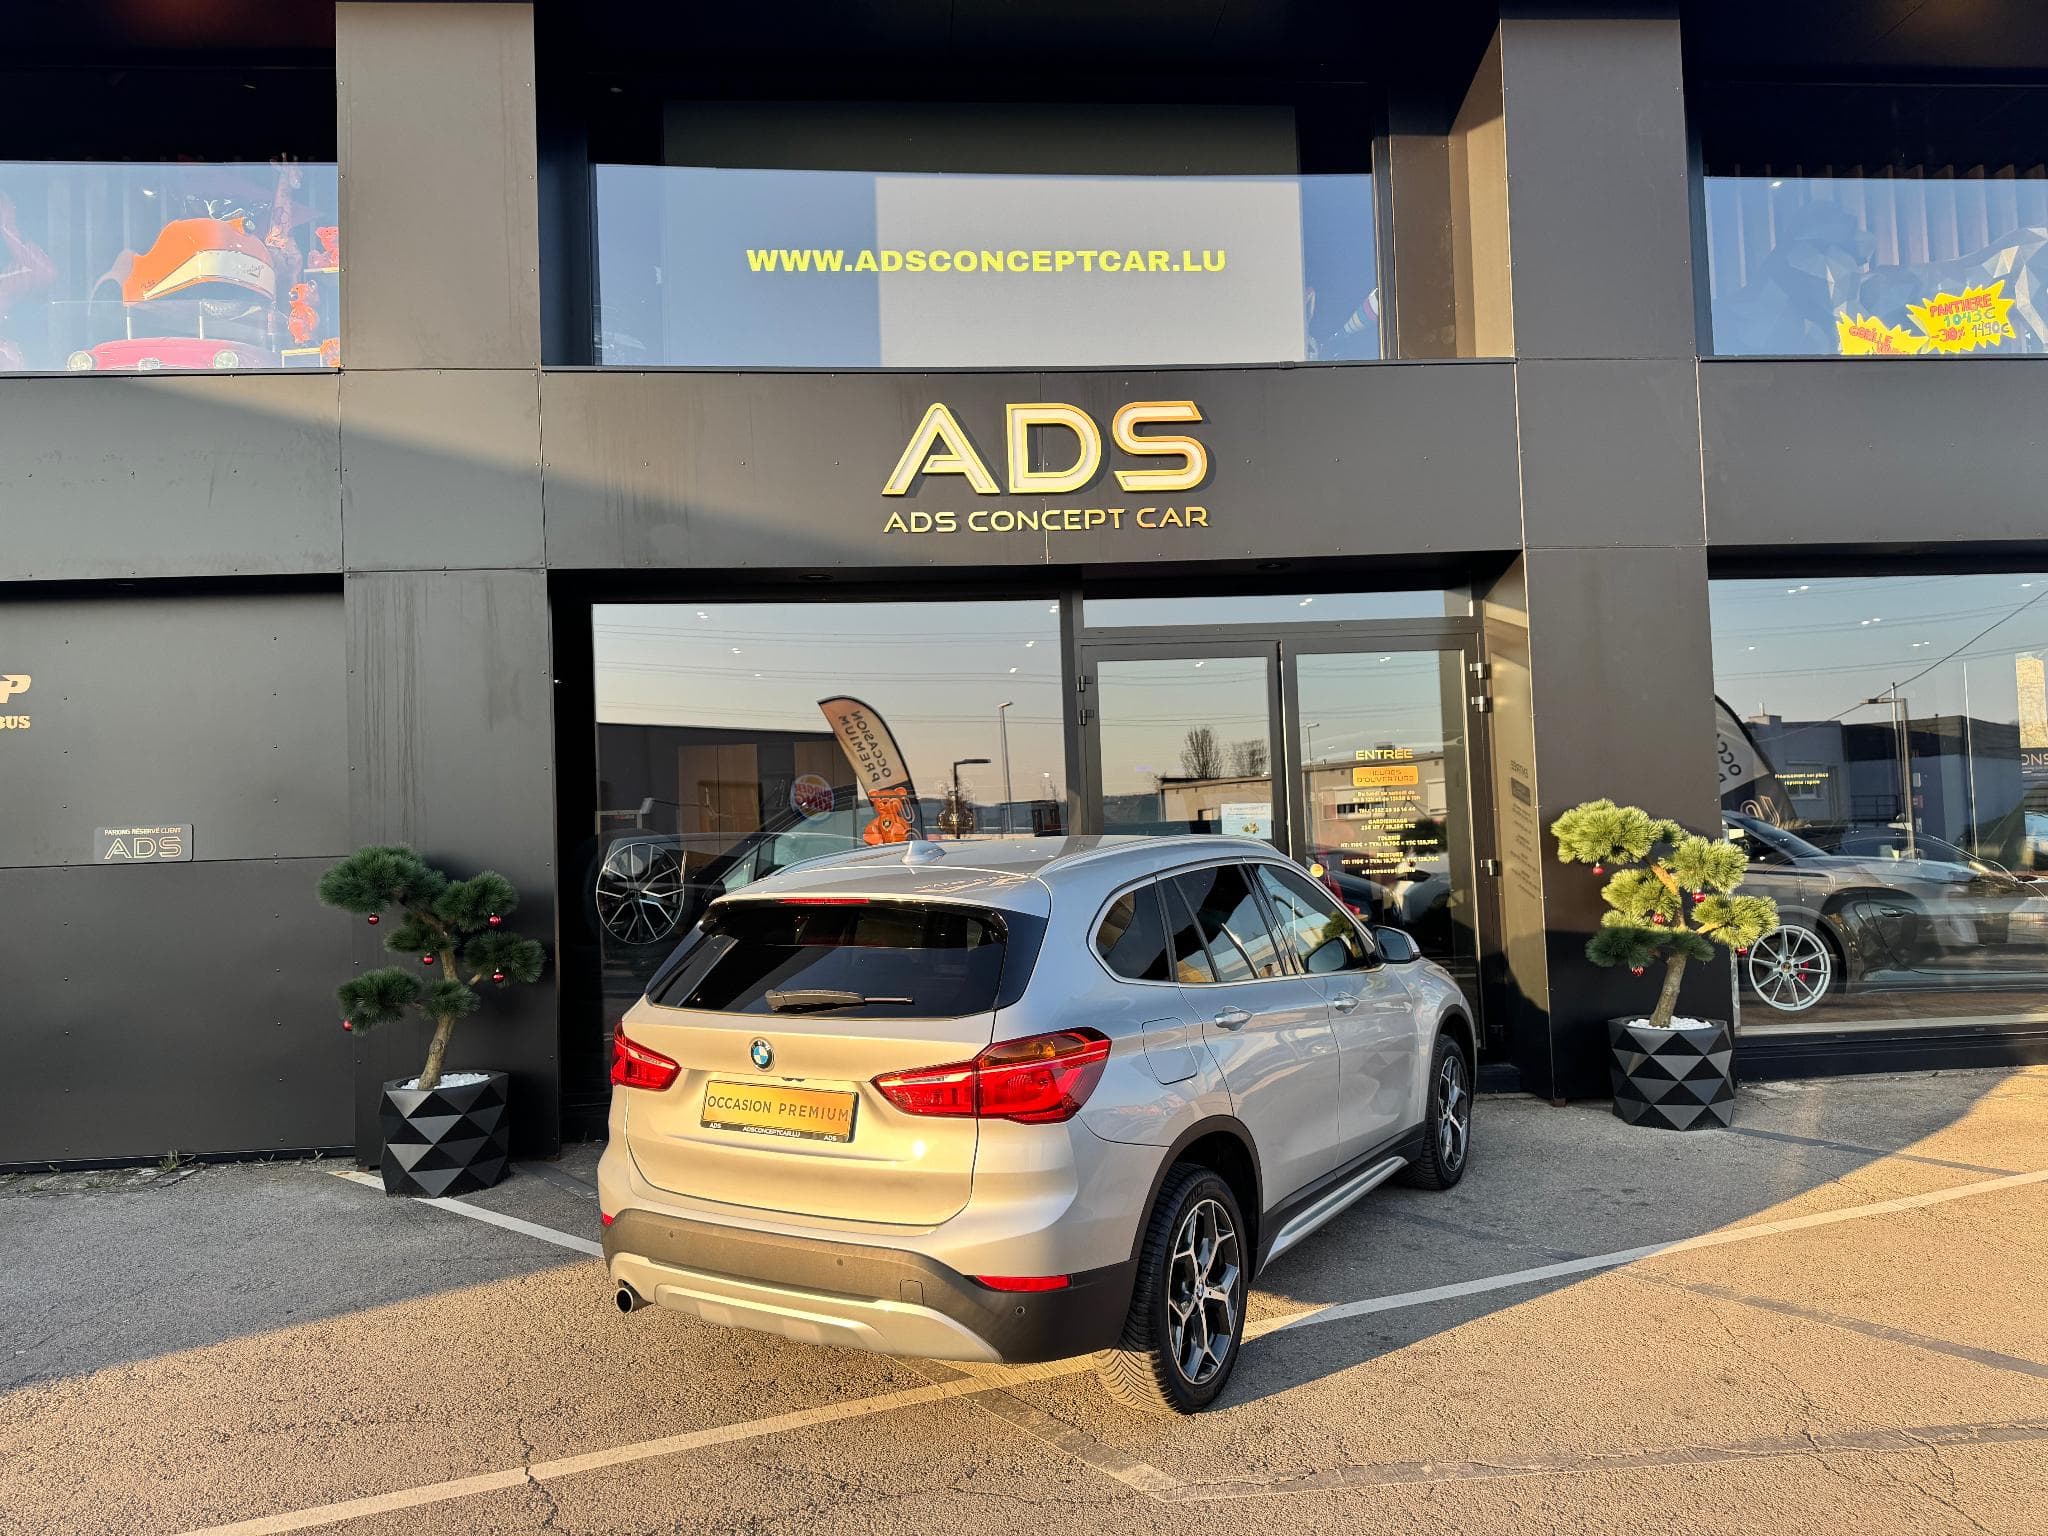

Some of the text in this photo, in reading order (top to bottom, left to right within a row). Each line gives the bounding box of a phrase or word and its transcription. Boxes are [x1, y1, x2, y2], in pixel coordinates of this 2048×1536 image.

[746, 249, 1226, 272] WWW.ADSCONCEPTCAR.LU
[881, 400, 1208, 496] ADS
[883, 506, 1209, 533] ADS CONCEPT CAR
[1355, 747, 1414, 761] ENTRÉE
[160, 826, 182, 834] CLIENT
[103, 836, 182, 860] ADS
[707, 1095, 849, 1122] OCCASION PREMIUM
